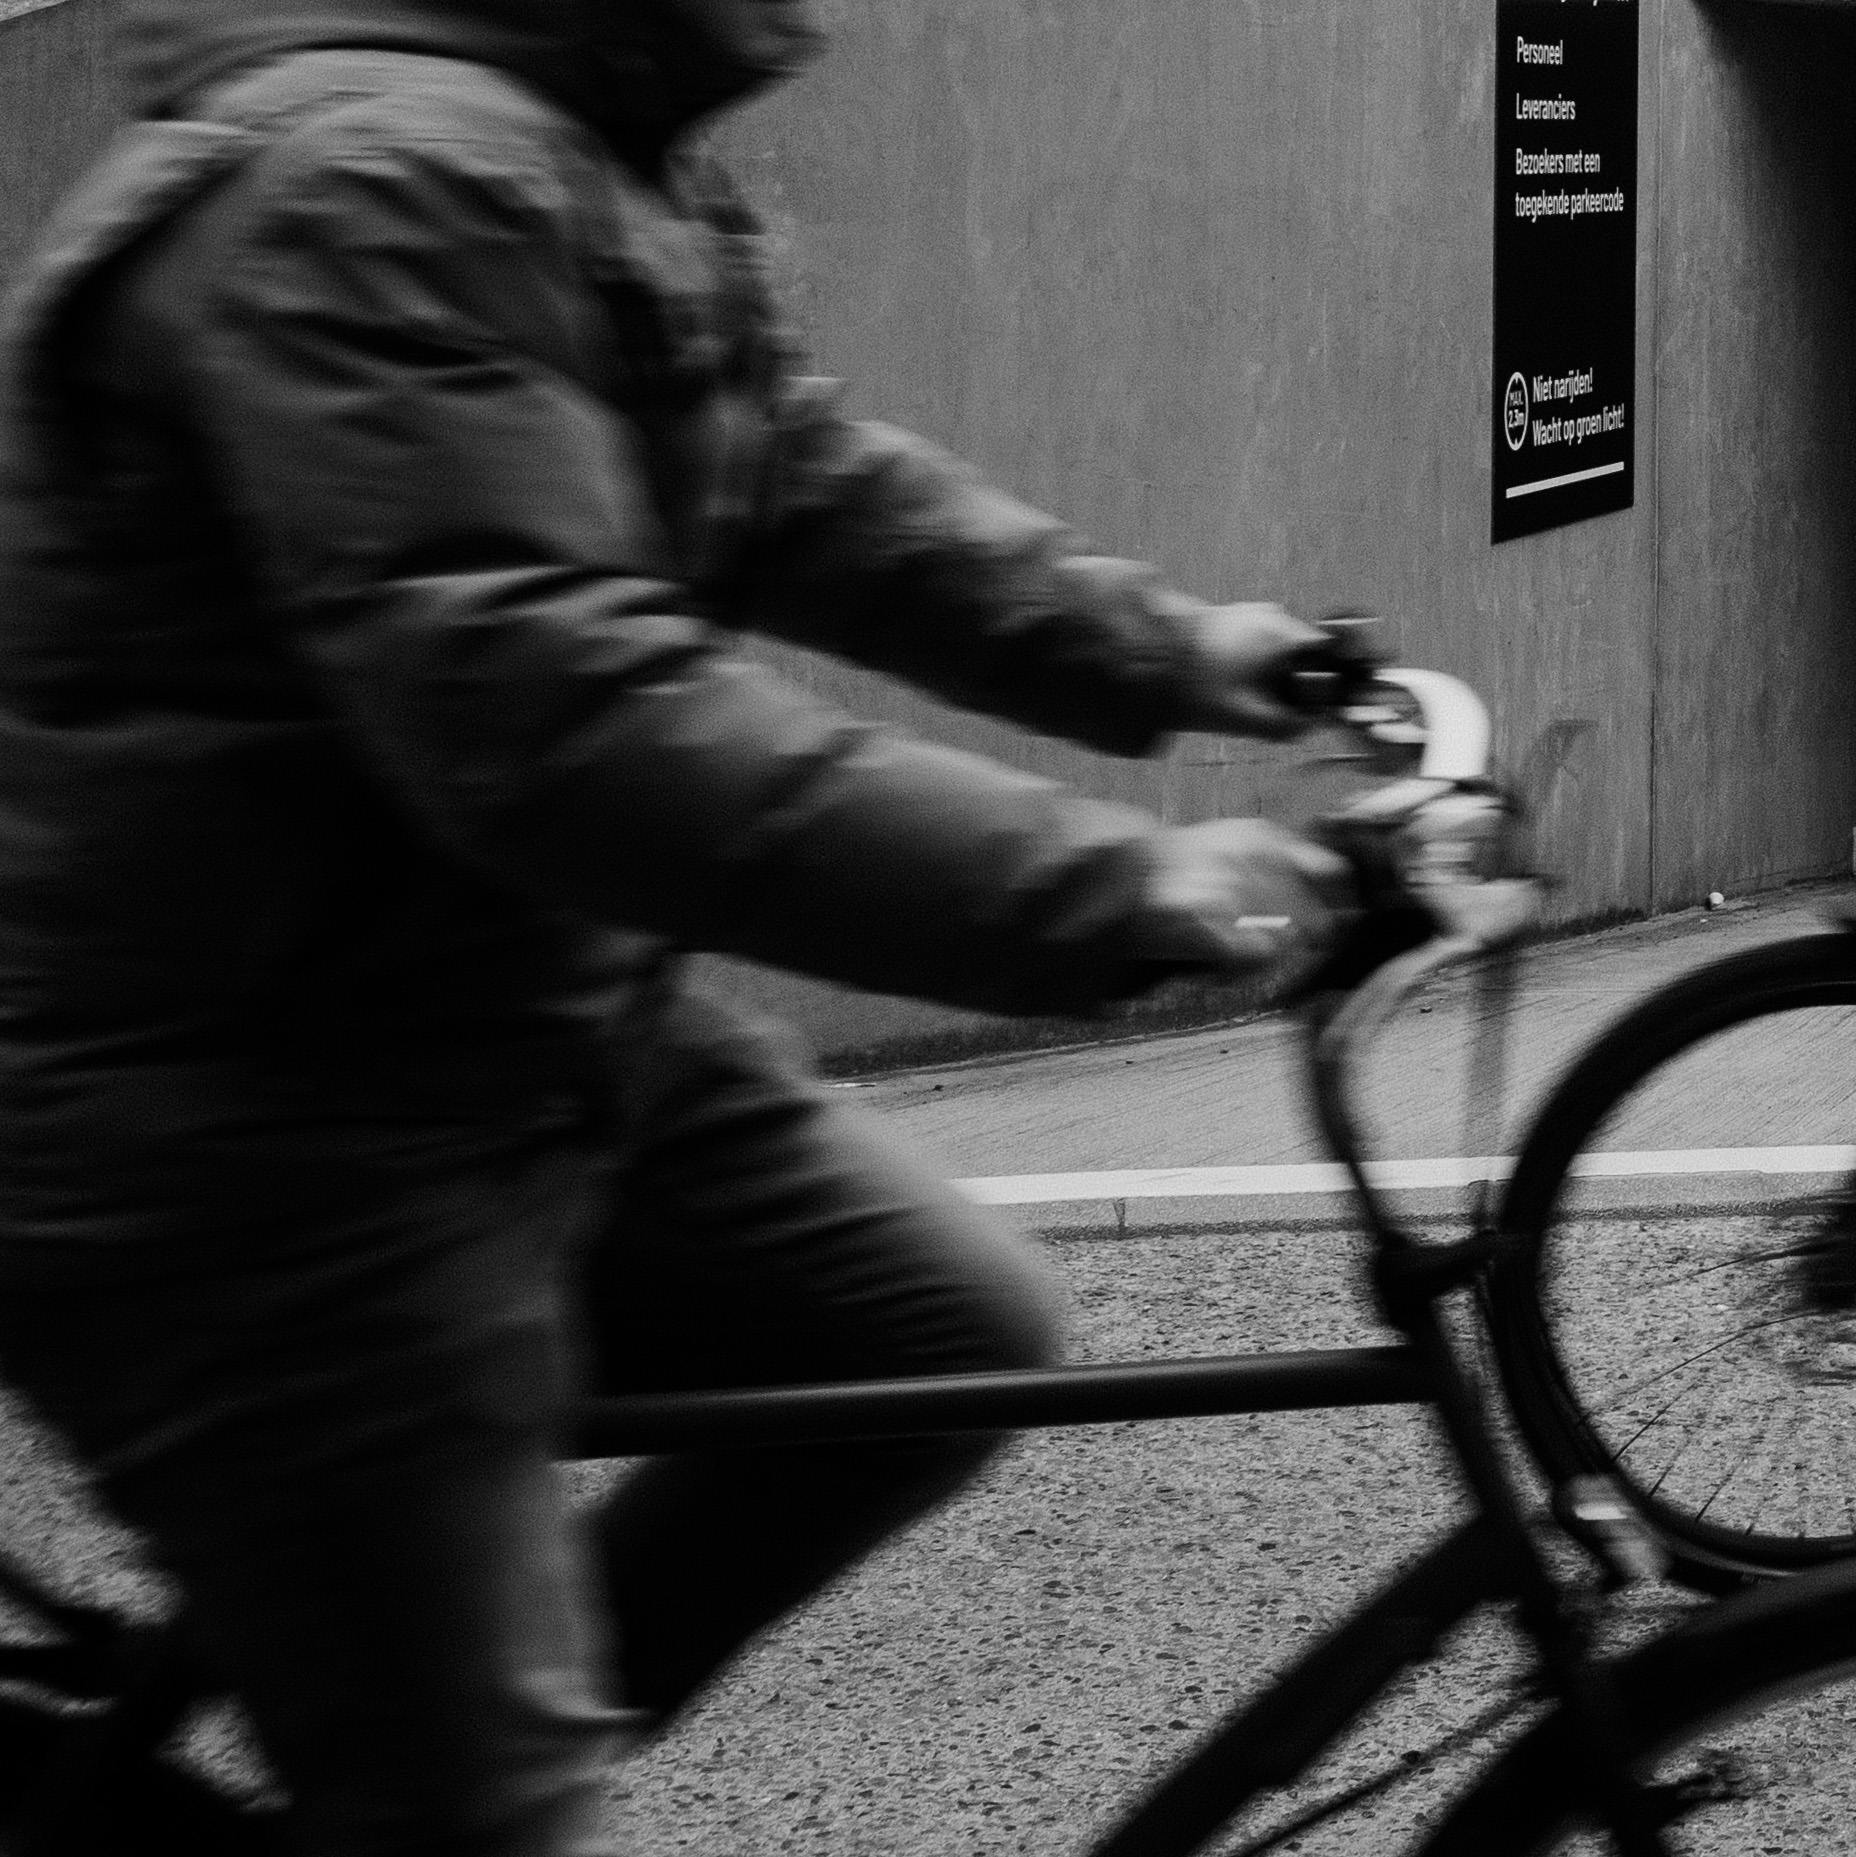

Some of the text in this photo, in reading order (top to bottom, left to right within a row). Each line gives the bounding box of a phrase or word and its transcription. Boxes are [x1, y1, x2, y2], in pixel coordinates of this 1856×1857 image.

[1517, 36, 1563, 65] Personeel
[1516, 93, 1576, 120] Leveranciers
[1516, 147, 1600, 175] Bezoekers met een
[1515, 186, 1624, 223] toegekende parkeercode
[1533, 367, 1593, 403] Niet narijden!
[1532, 402, 1624, 447] Wacht op groen licht!
